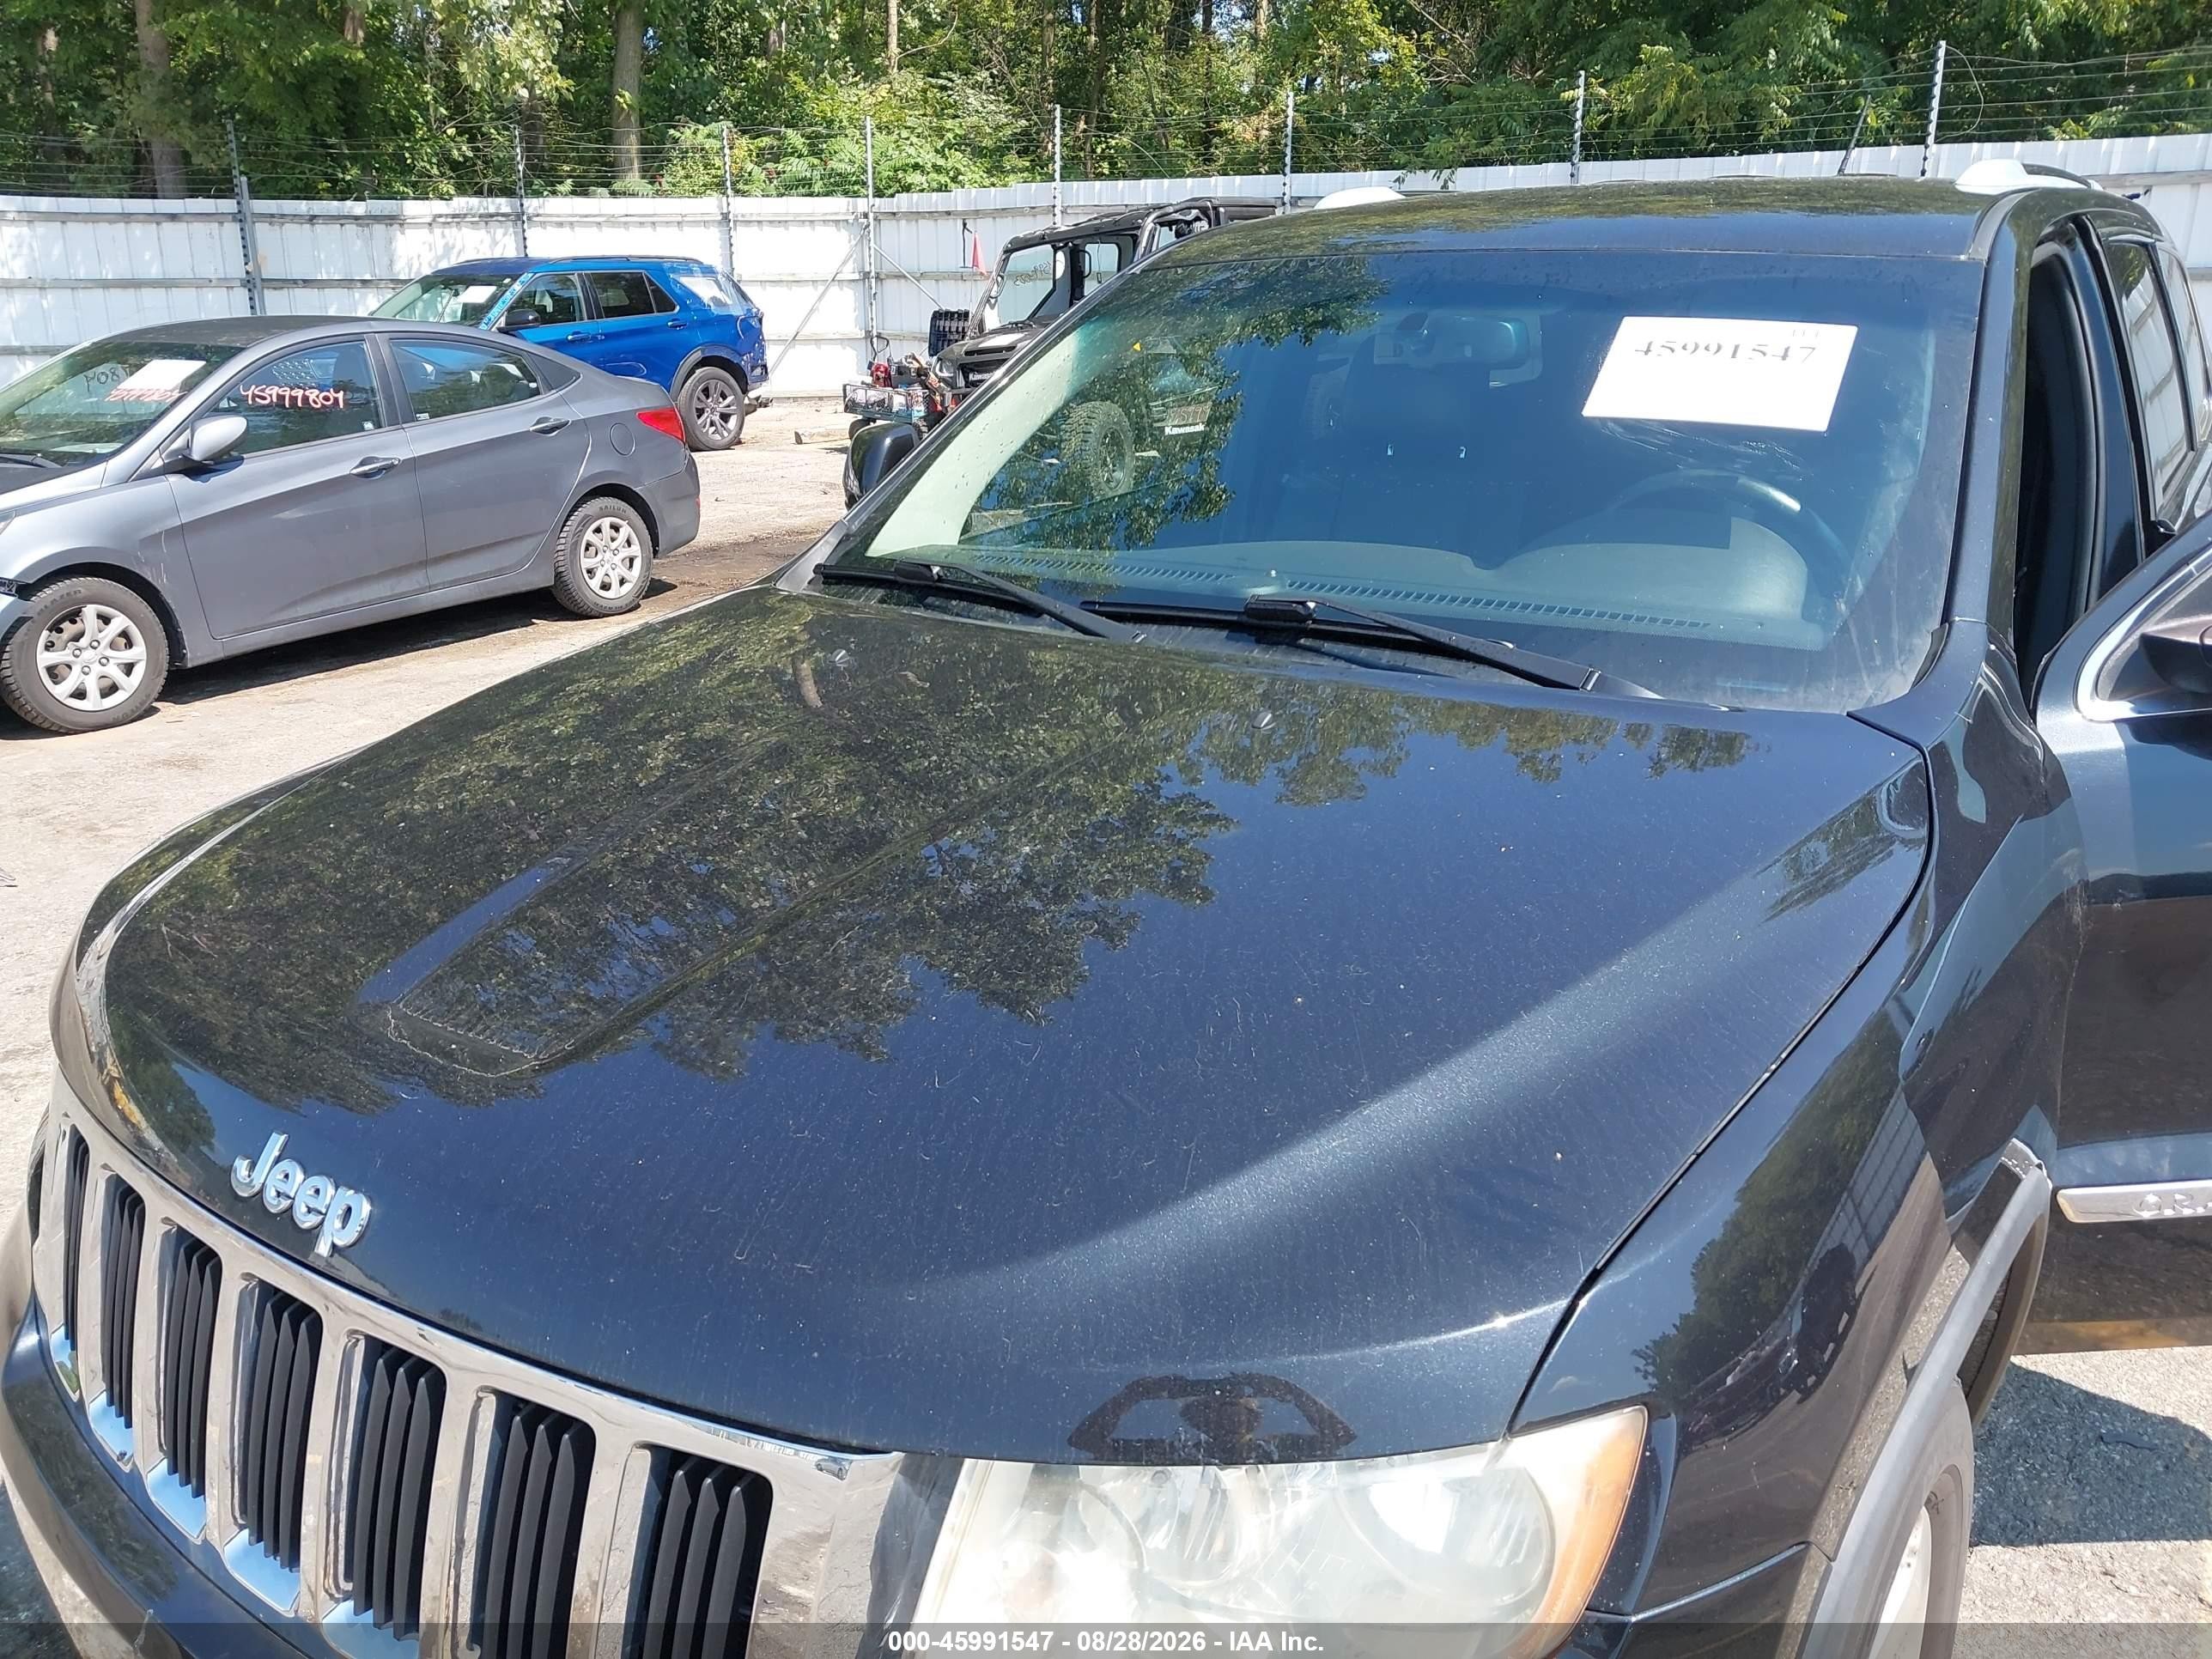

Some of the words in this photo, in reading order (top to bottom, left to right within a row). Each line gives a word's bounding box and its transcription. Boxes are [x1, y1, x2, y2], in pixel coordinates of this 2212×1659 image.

[1634, 340, 1817, 362] 45991547
[240, 384, 344, 410] 45999804
[230, 1132, 372, 1257] Jeep
